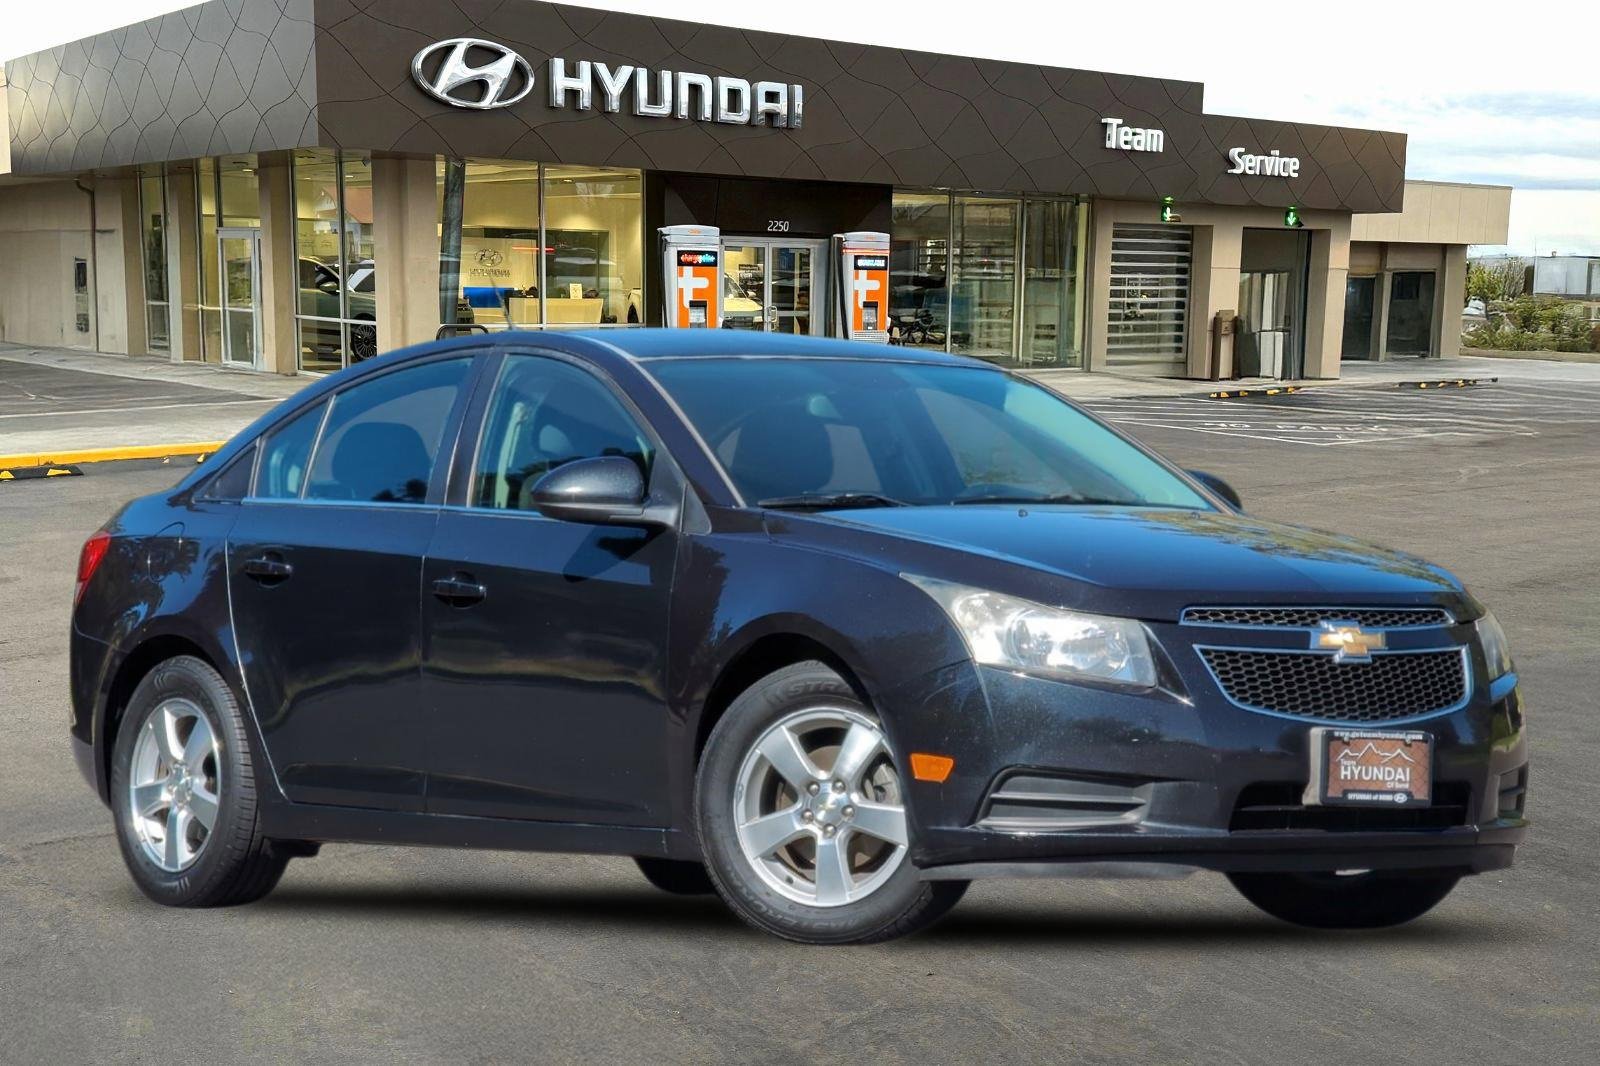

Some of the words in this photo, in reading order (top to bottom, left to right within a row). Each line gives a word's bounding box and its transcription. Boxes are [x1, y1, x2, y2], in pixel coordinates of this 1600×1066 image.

[548, 57, 803, 129] HYUNDAI
[1101, 117, 1164, 153] Team
[1227, 147, 1300, 178] Service
[767, 220, 790, 233] 2250
[1340, 766, 1410, 782] HYUNDAI
